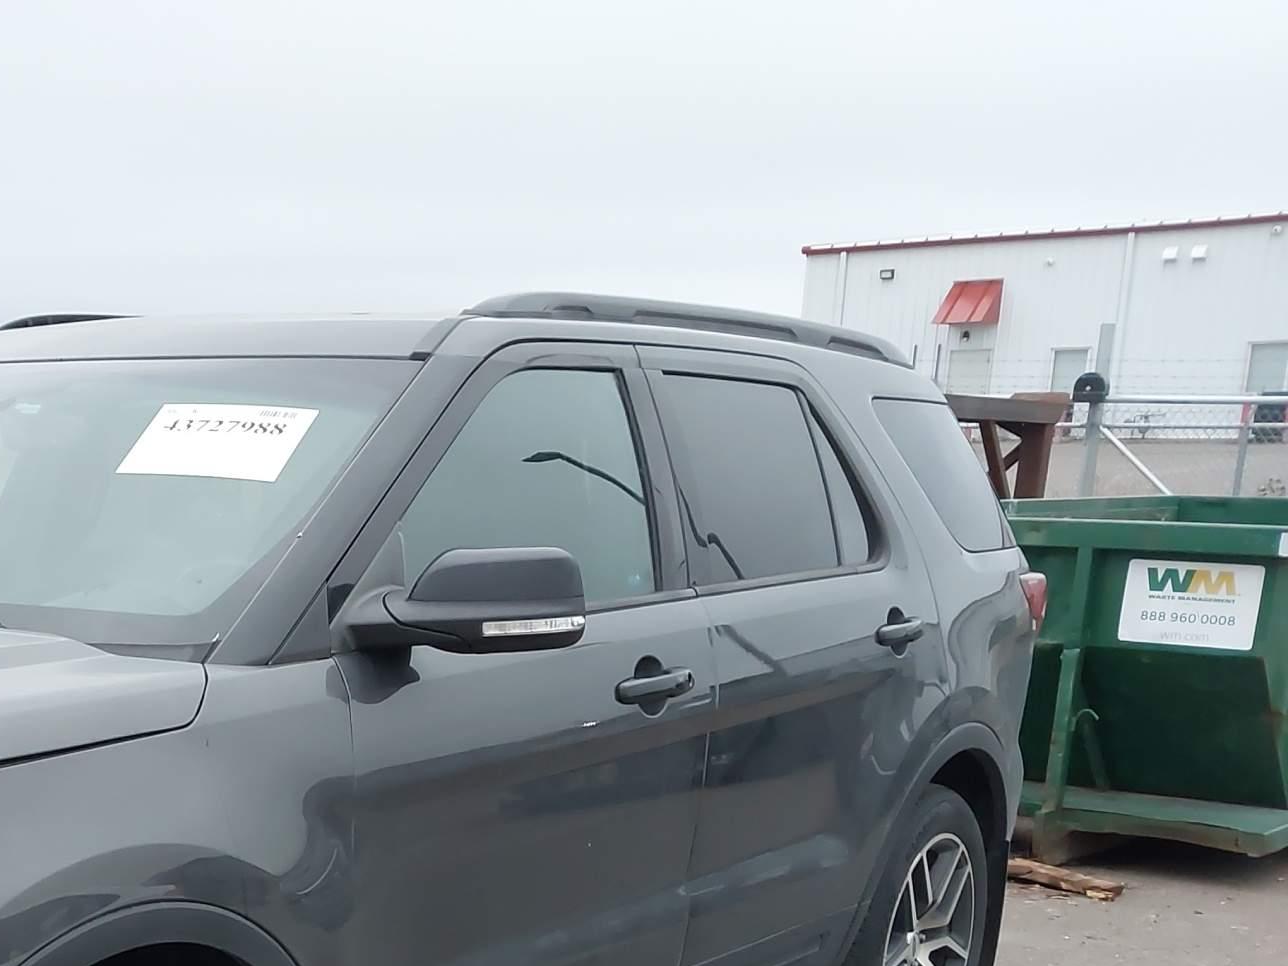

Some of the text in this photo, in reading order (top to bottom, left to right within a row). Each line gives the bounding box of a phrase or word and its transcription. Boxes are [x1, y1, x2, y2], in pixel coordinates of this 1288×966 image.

[164, 418, 287, 436] 43727988
[1147, 567, 1237, 596] WM
[1140, 609, 1236, 626] 888 960 0008
